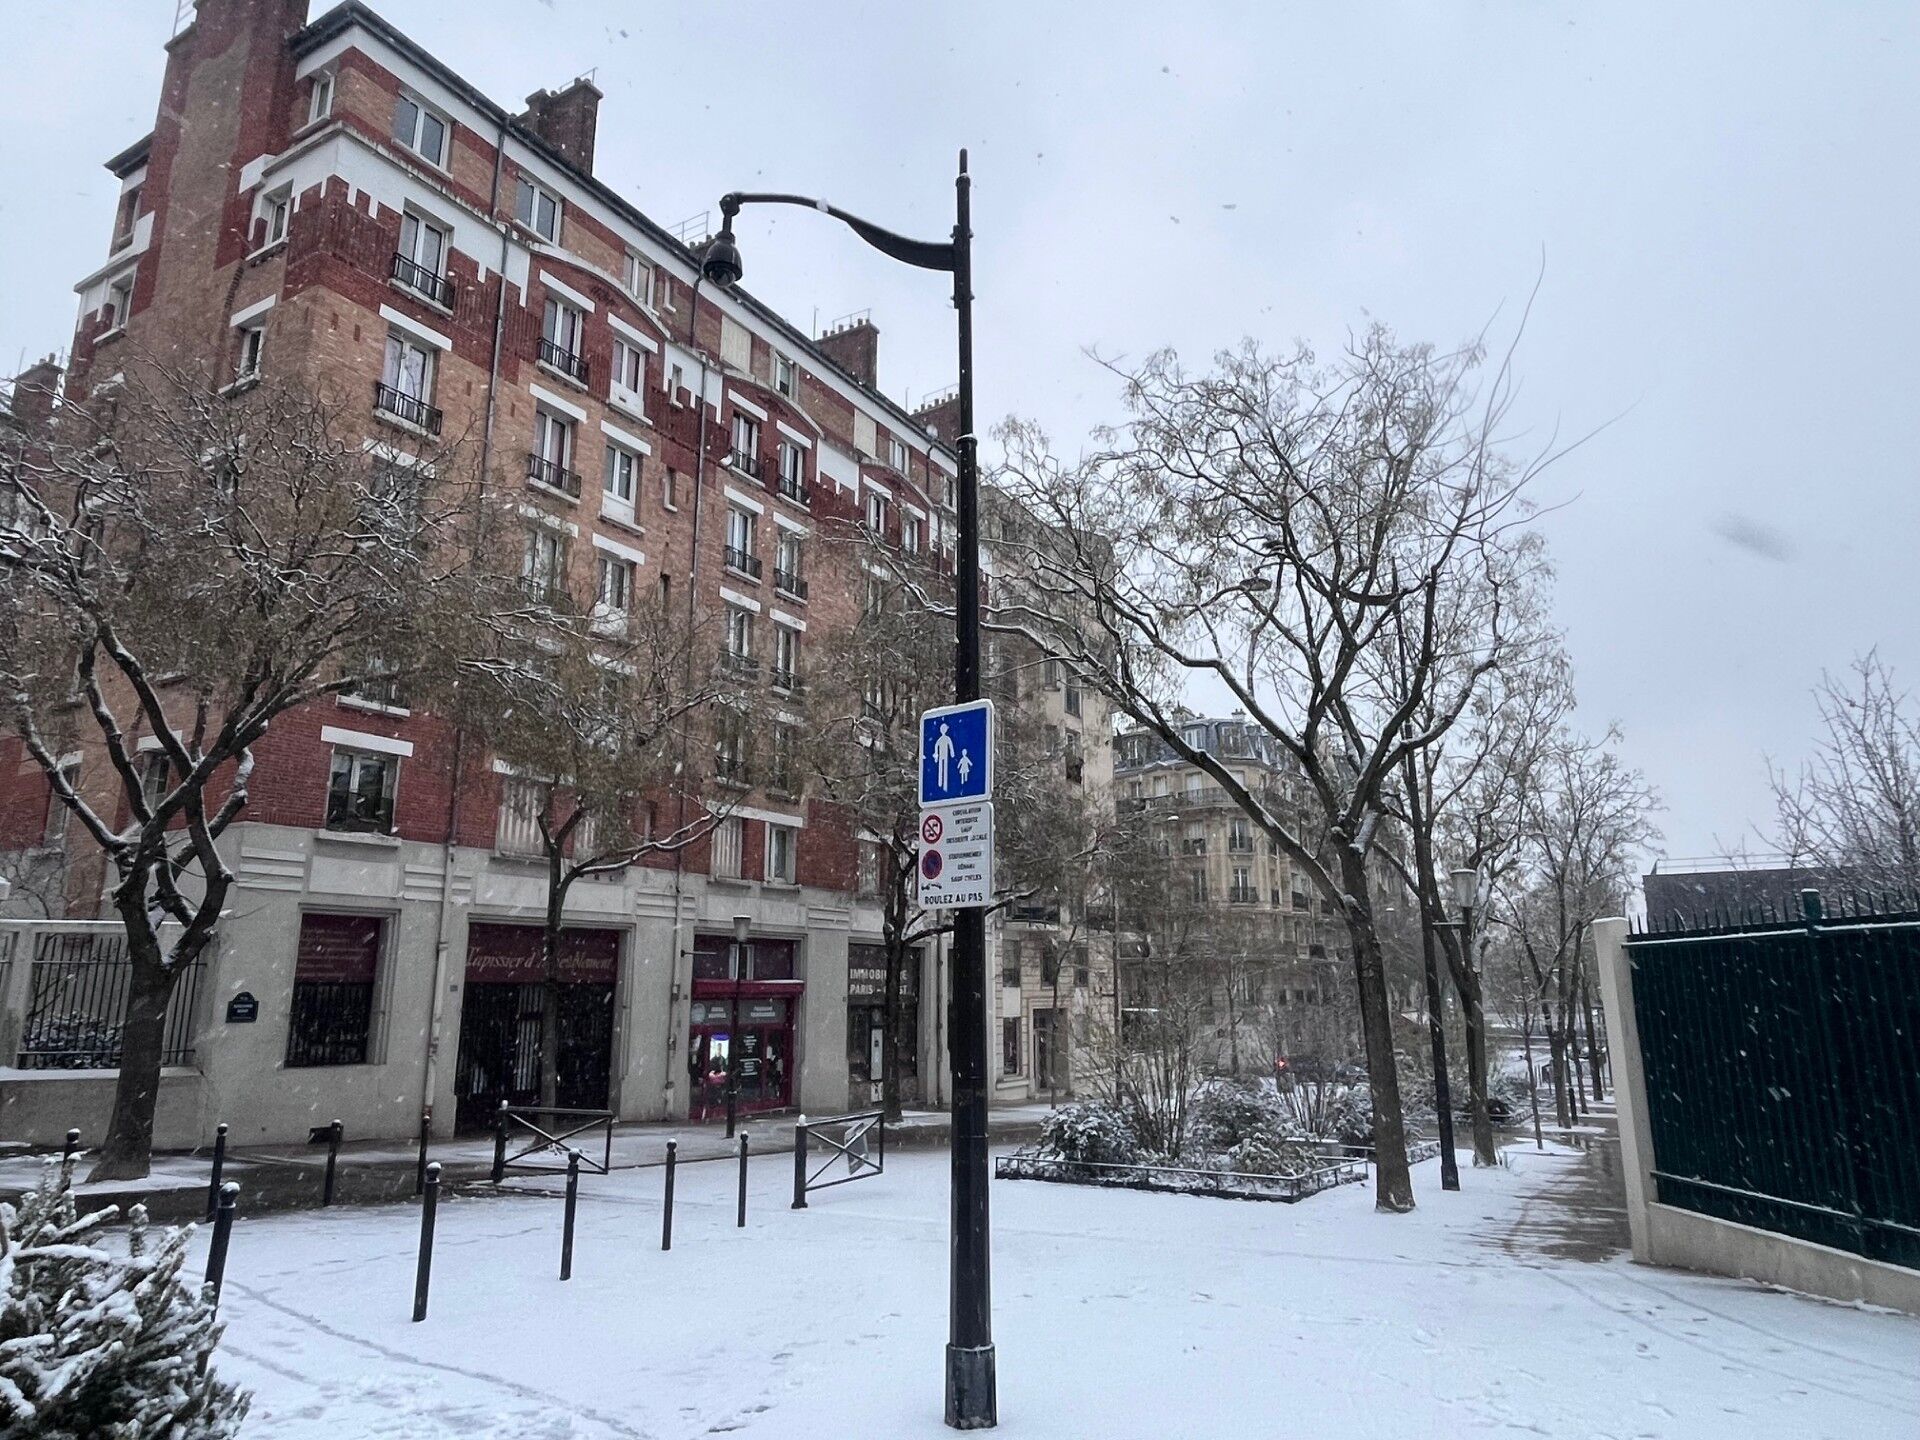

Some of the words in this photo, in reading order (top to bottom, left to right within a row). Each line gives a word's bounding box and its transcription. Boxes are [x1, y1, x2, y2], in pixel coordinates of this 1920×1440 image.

[924, 894, 953, 905] ROULEZ
[955, 893, 966, 903] AU
[968, 892, 983, 902] PAS
[850, 968, 907, 981] IMMOBIE
[850, 984, 873, 995] PARIS
